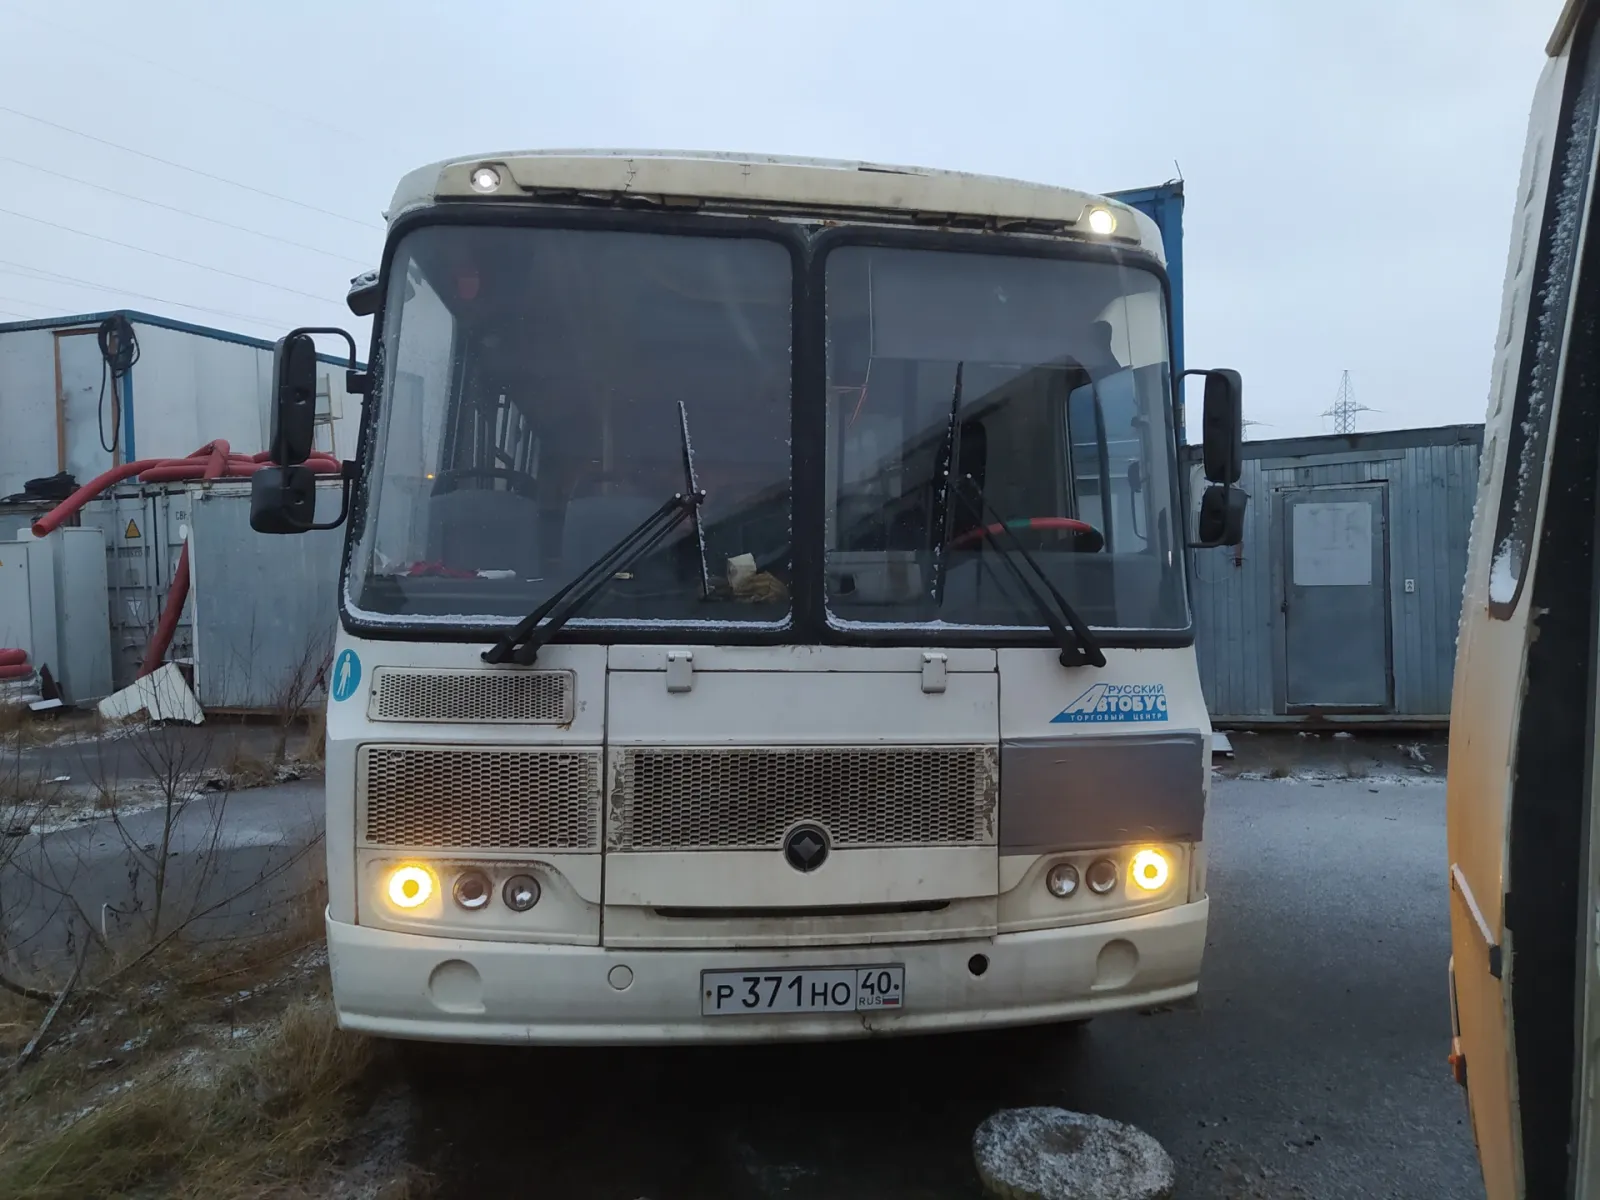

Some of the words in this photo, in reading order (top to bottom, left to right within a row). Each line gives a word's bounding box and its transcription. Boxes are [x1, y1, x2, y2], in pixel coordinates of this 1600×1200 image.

[1108, 683, 1164, 694] РУССКИЙ
[1063, 684, 1166, 713] АВТОБУС
[861, 971, 892, 995] 40
[859, 995, 882, 1006] RUS
